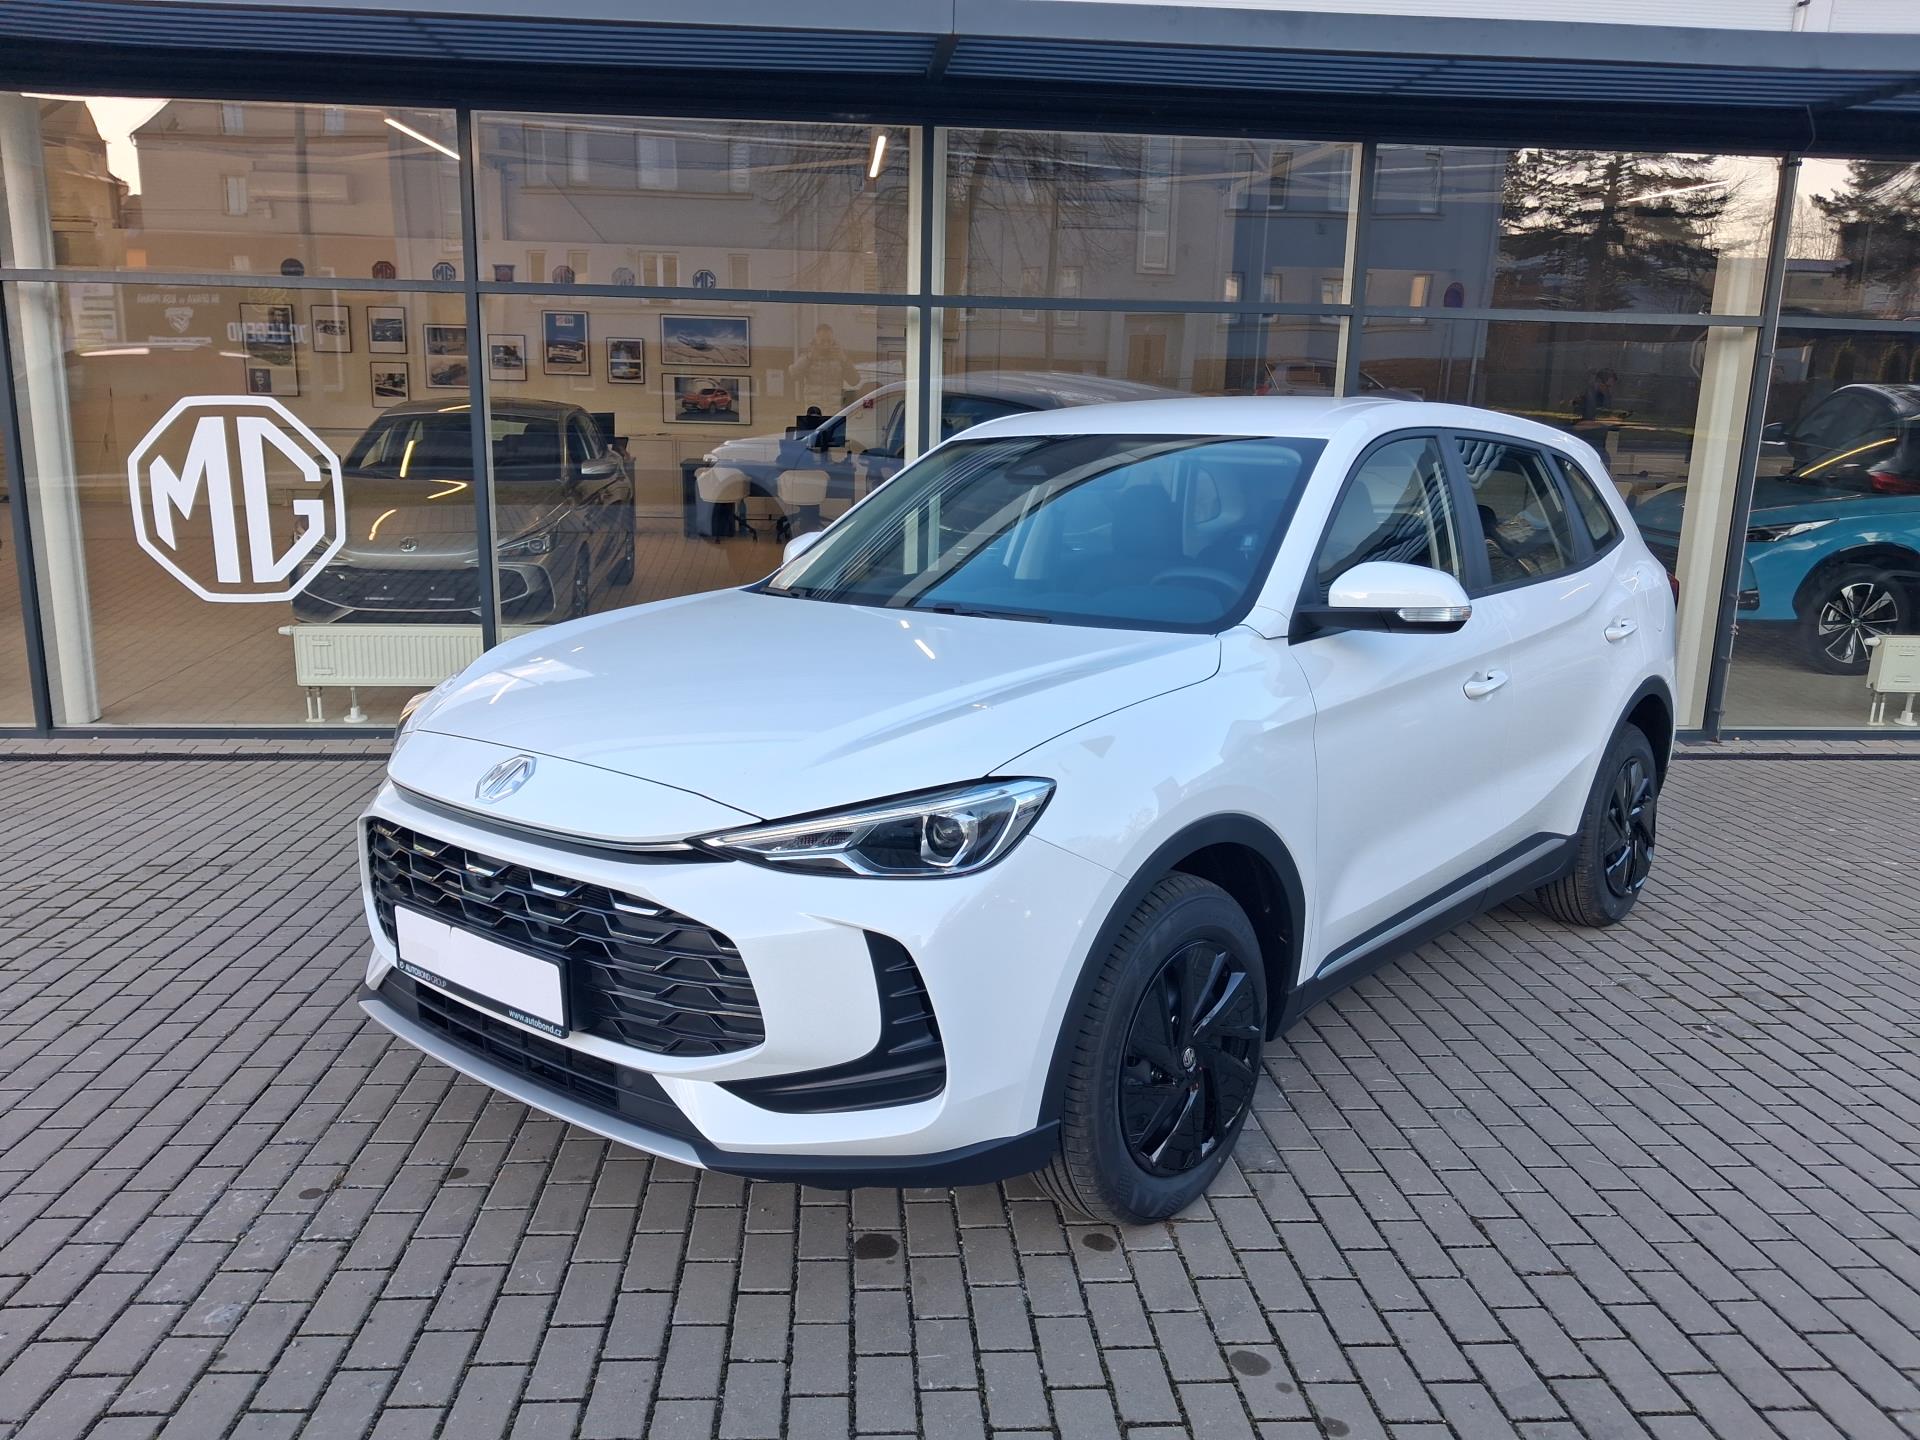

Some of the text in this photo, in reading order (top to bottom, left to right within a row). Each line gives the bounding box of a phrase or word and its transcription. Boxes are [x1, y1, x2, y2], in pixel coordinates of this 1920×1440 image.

[434, 264, 453, 280] MG
[694, 271, 715, 288] MG
[149, 415, 326, 584] MG
[508, 1009, 562, 1037] www.autobond.cz
